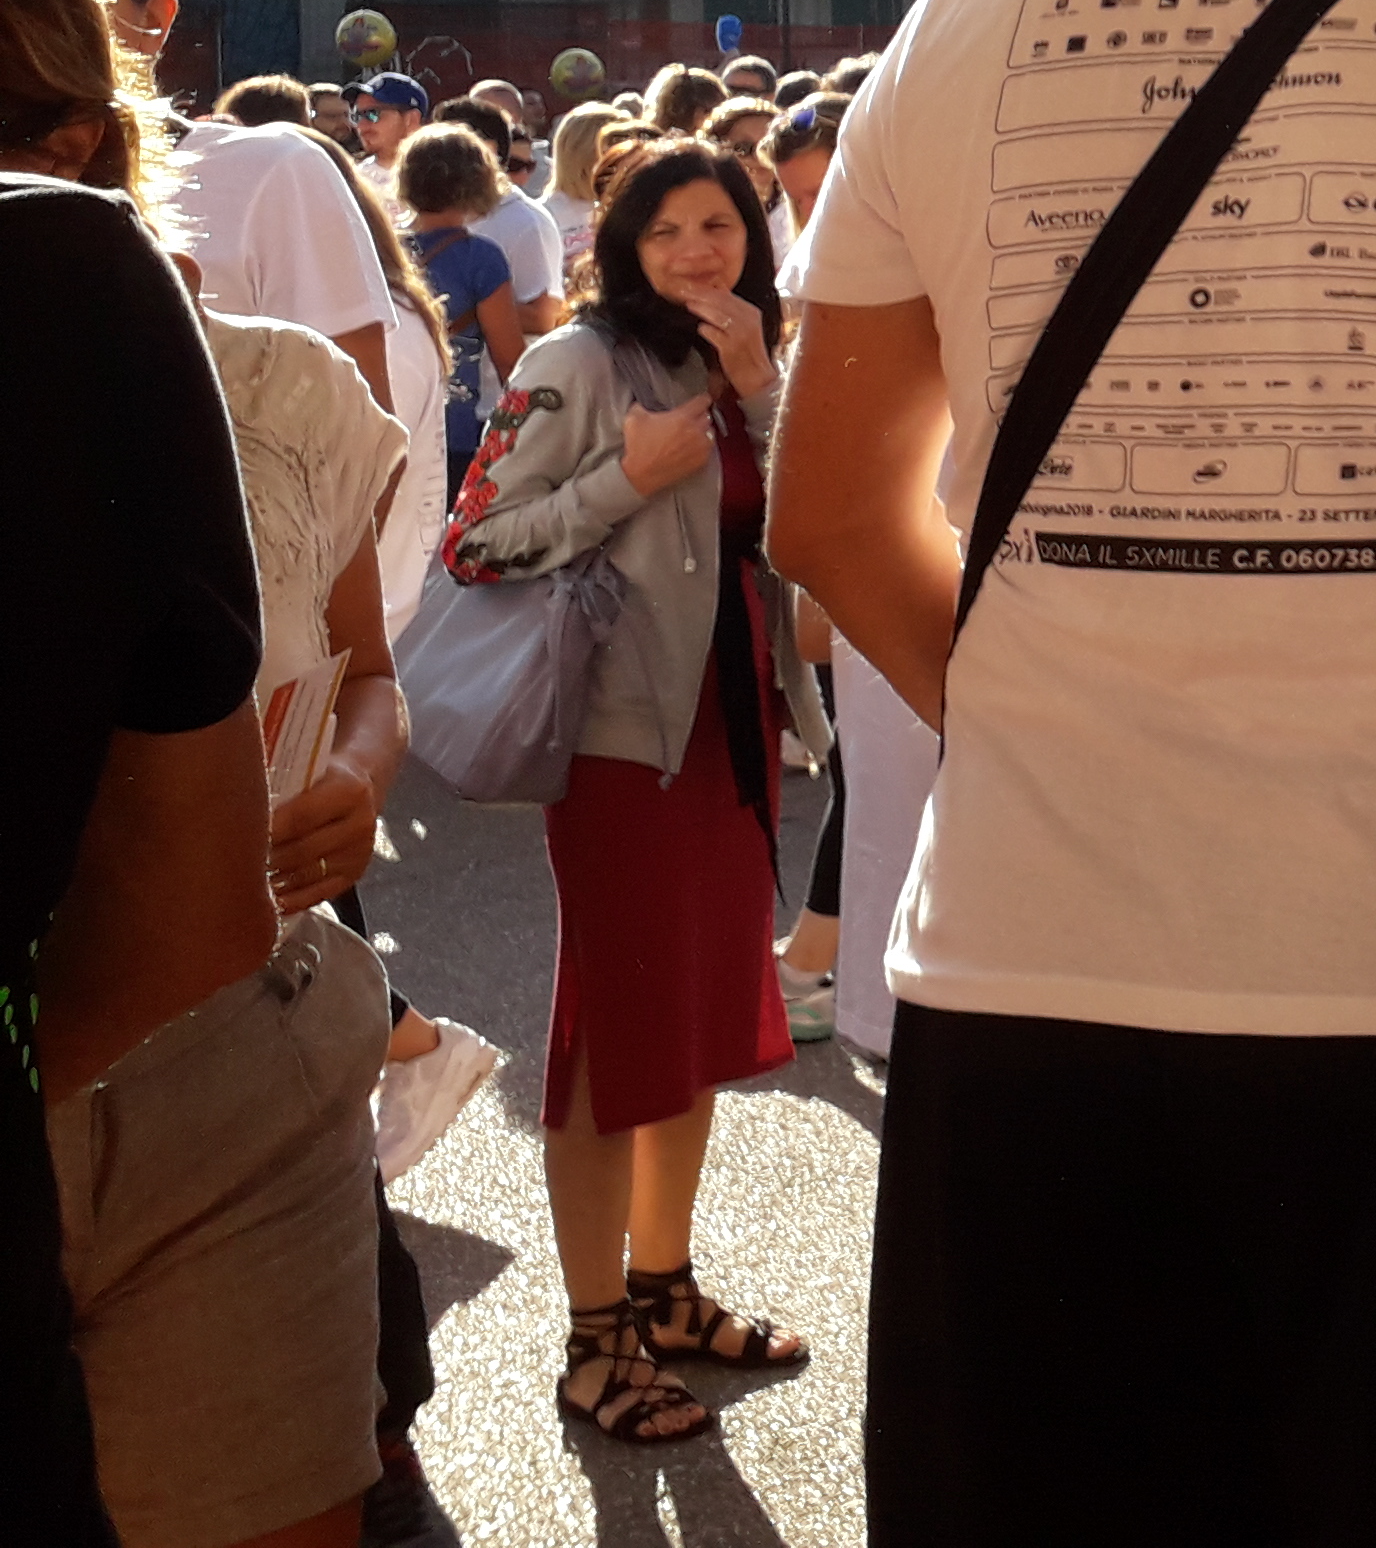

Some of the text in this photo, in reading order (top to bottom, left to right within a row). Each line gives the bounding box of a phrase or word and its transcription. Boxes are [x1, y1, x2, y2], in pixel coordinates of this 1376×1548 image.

[1212, 195, 1252, 220] sky
[1109, 504, 1183, 522] GIARDINI
[1186, 505, 1283, 524] MARGHERITA
[1298, 507, 1317, 523] 23
[1038, 540, 1092, 565] DONA
[1097, 543, 1118, 565] IL
[1232, 547, 1274, 570] C.F.
